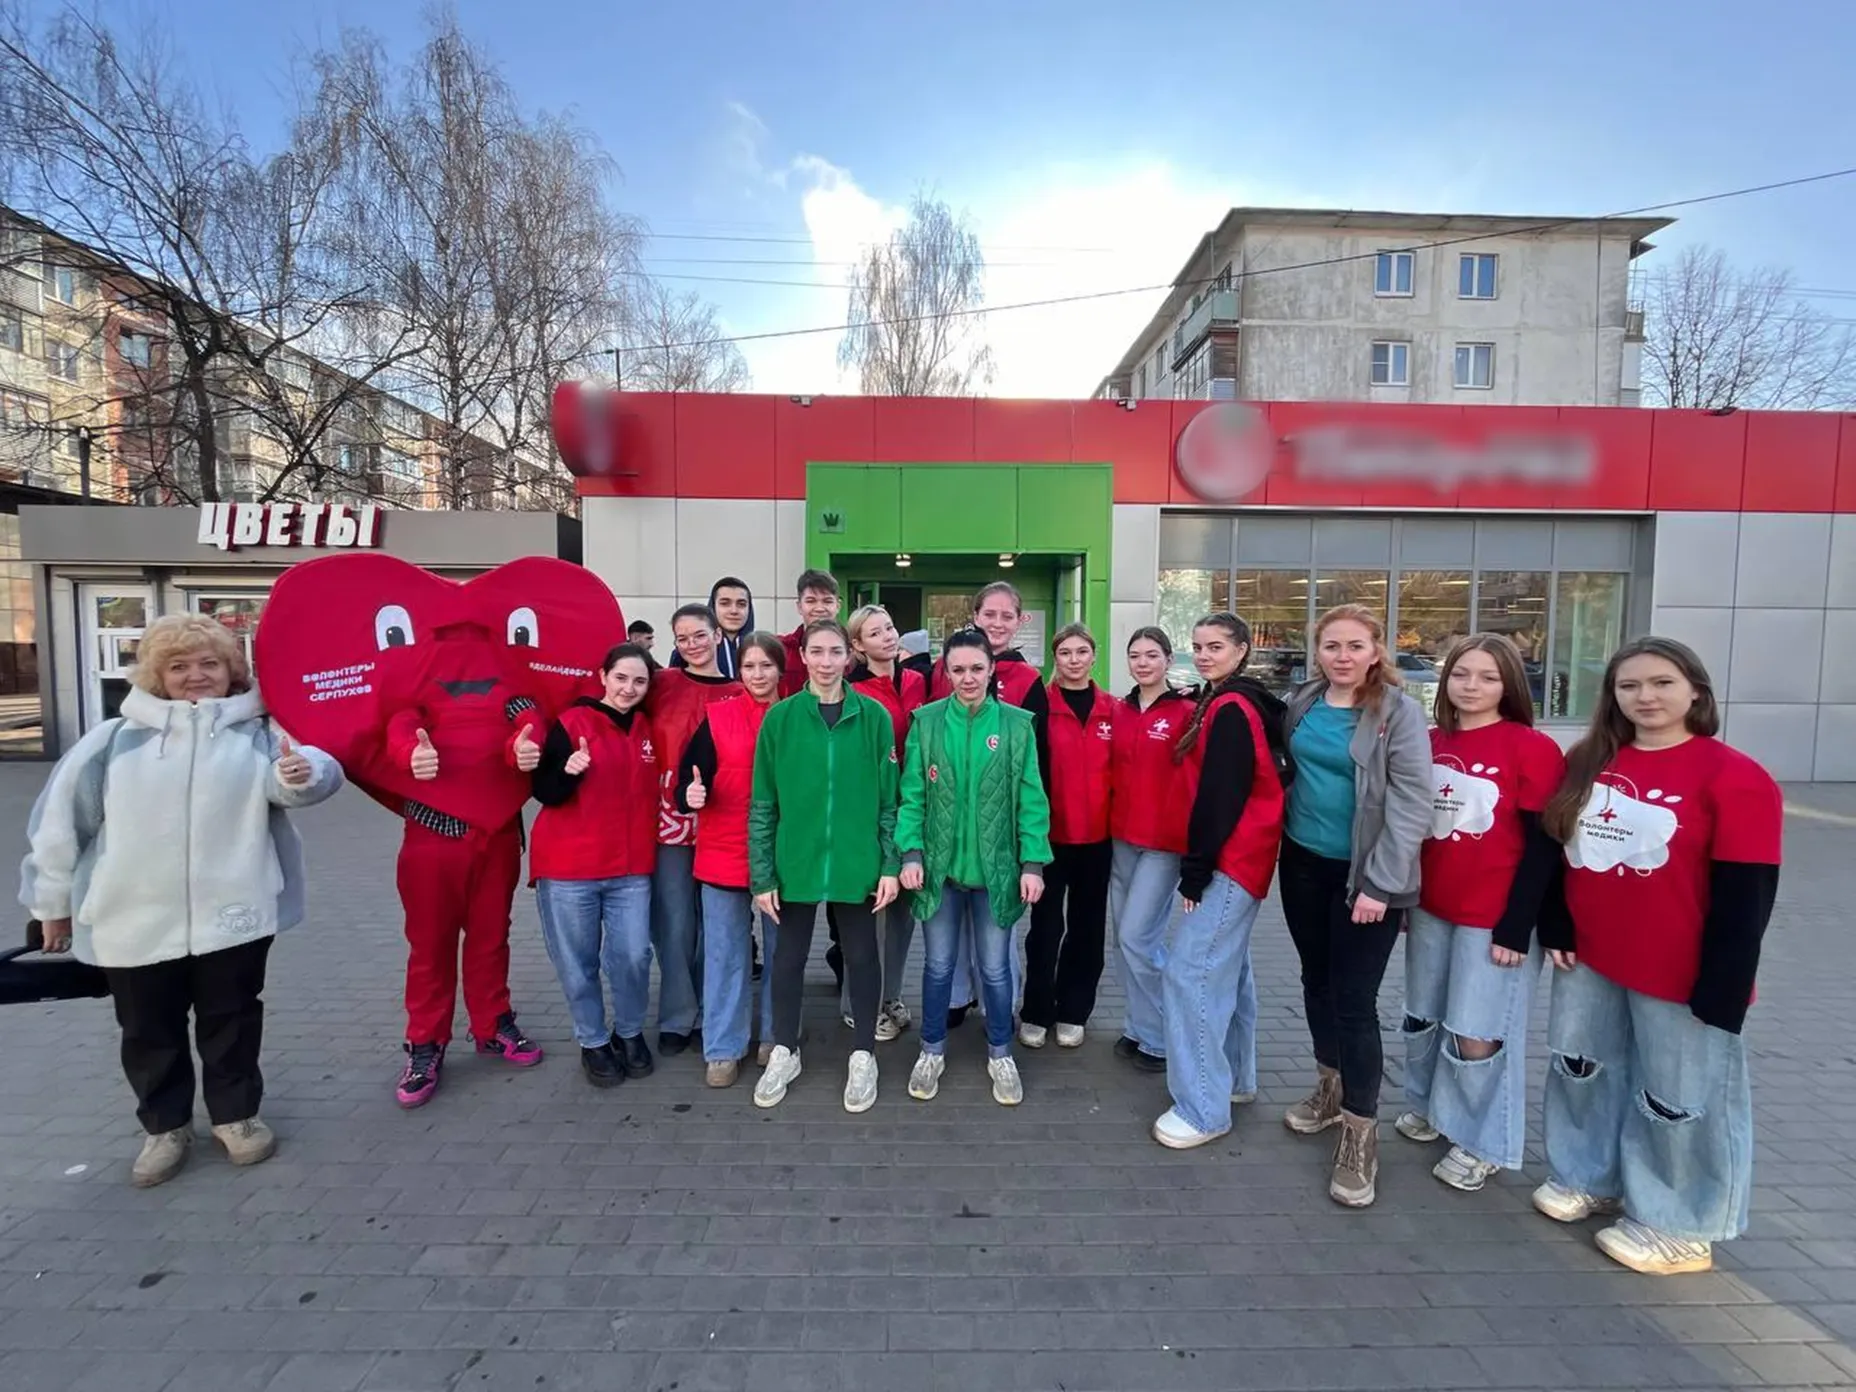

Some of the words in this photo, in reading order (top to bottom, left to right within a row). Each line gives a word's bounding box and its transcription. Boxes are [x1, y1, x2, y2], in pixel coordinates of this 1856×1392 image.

[198, 502, 380, 550] ЦВЕТЫ
[302, 662, 375, 683] ВОЛОНТЕРЫ
[315, 675, 363, 691] МЕДИКИ
[309, 684, 372, 702] СЕРПУХОВ
[1579, 818, 1634, 836] Волонтеры
[1587, 830, 1625, 842] медики
